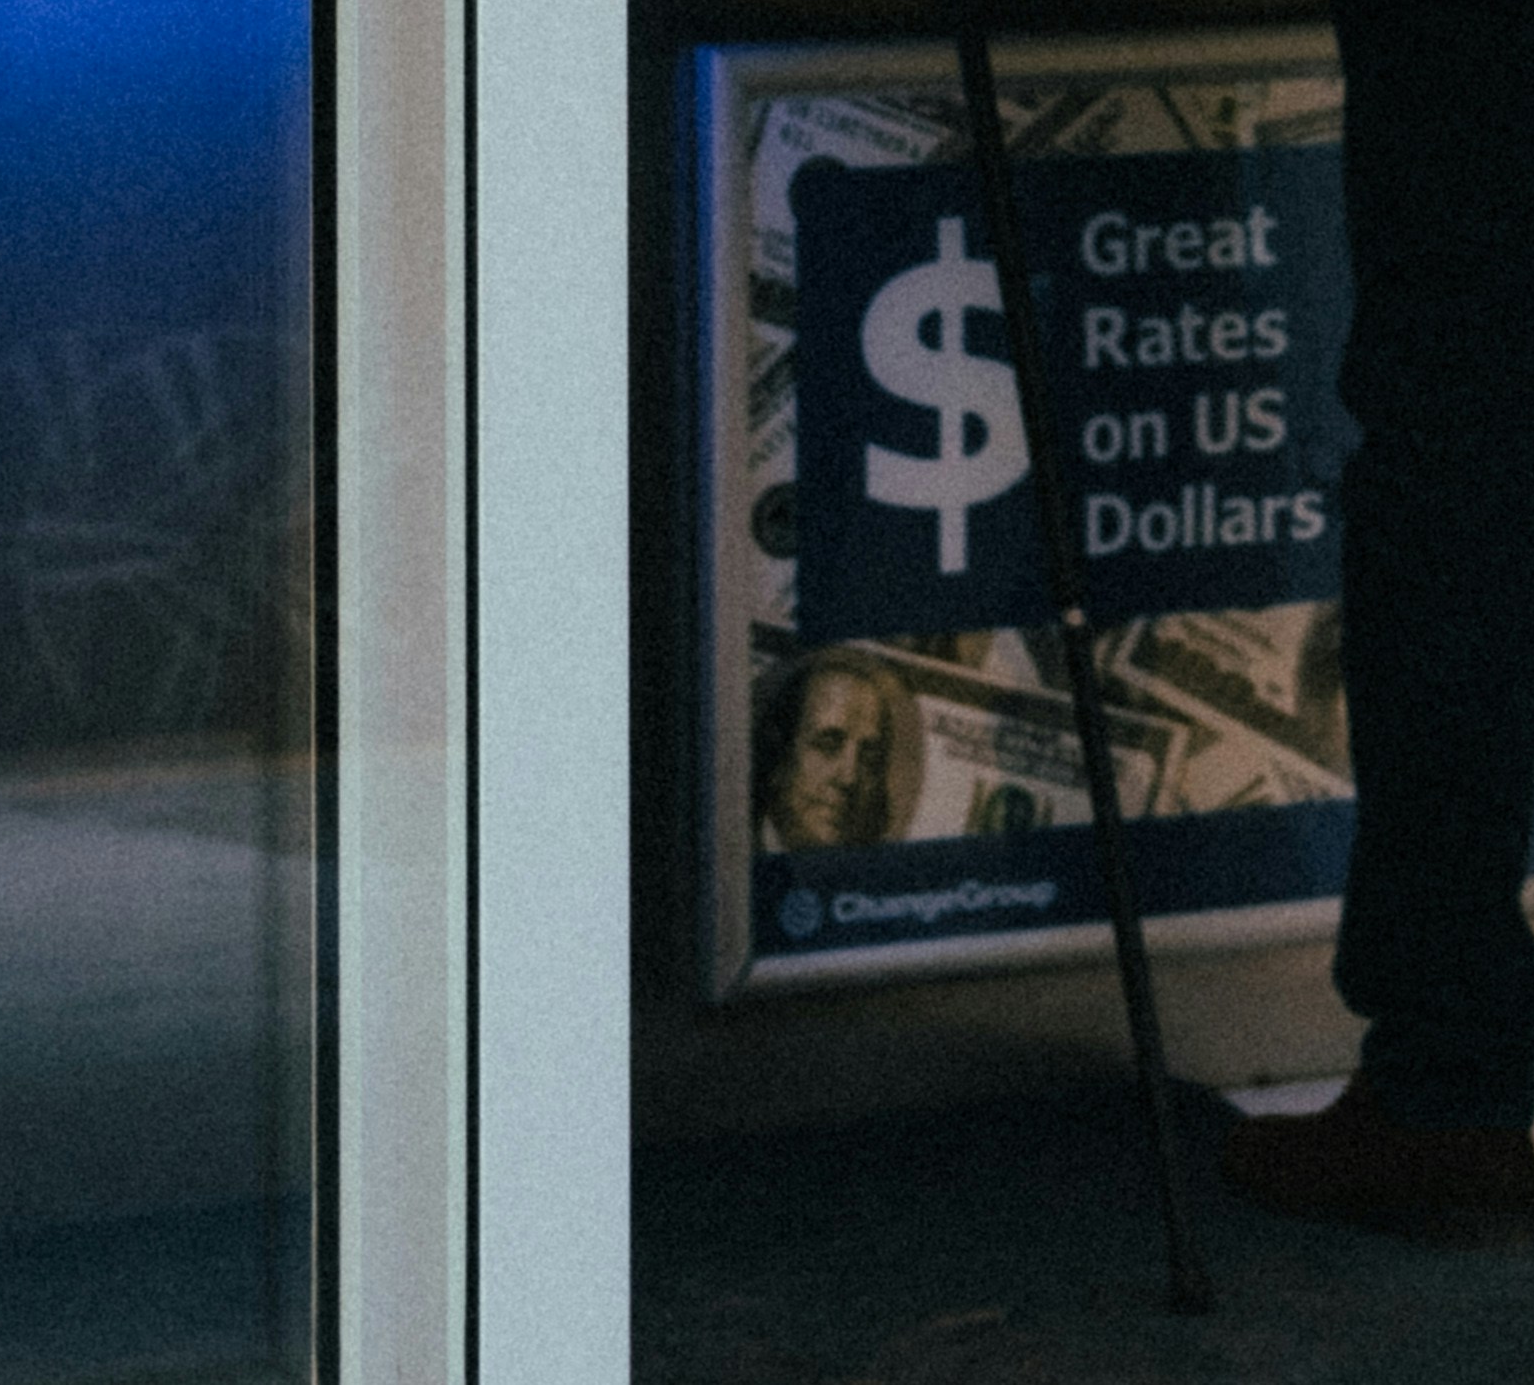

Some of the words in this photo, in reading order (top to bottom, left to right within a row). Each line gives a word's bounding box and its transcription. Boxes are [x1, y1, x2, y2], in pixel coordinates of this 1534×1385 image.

[1079, 205, 1278, 277] Great
[1082, 305, 1289, 370] Rates
[1081, 405, 1170, 462] on
[1193, 387, 1286, 457] US
[1083, 483, 1327, 556] Dollars
